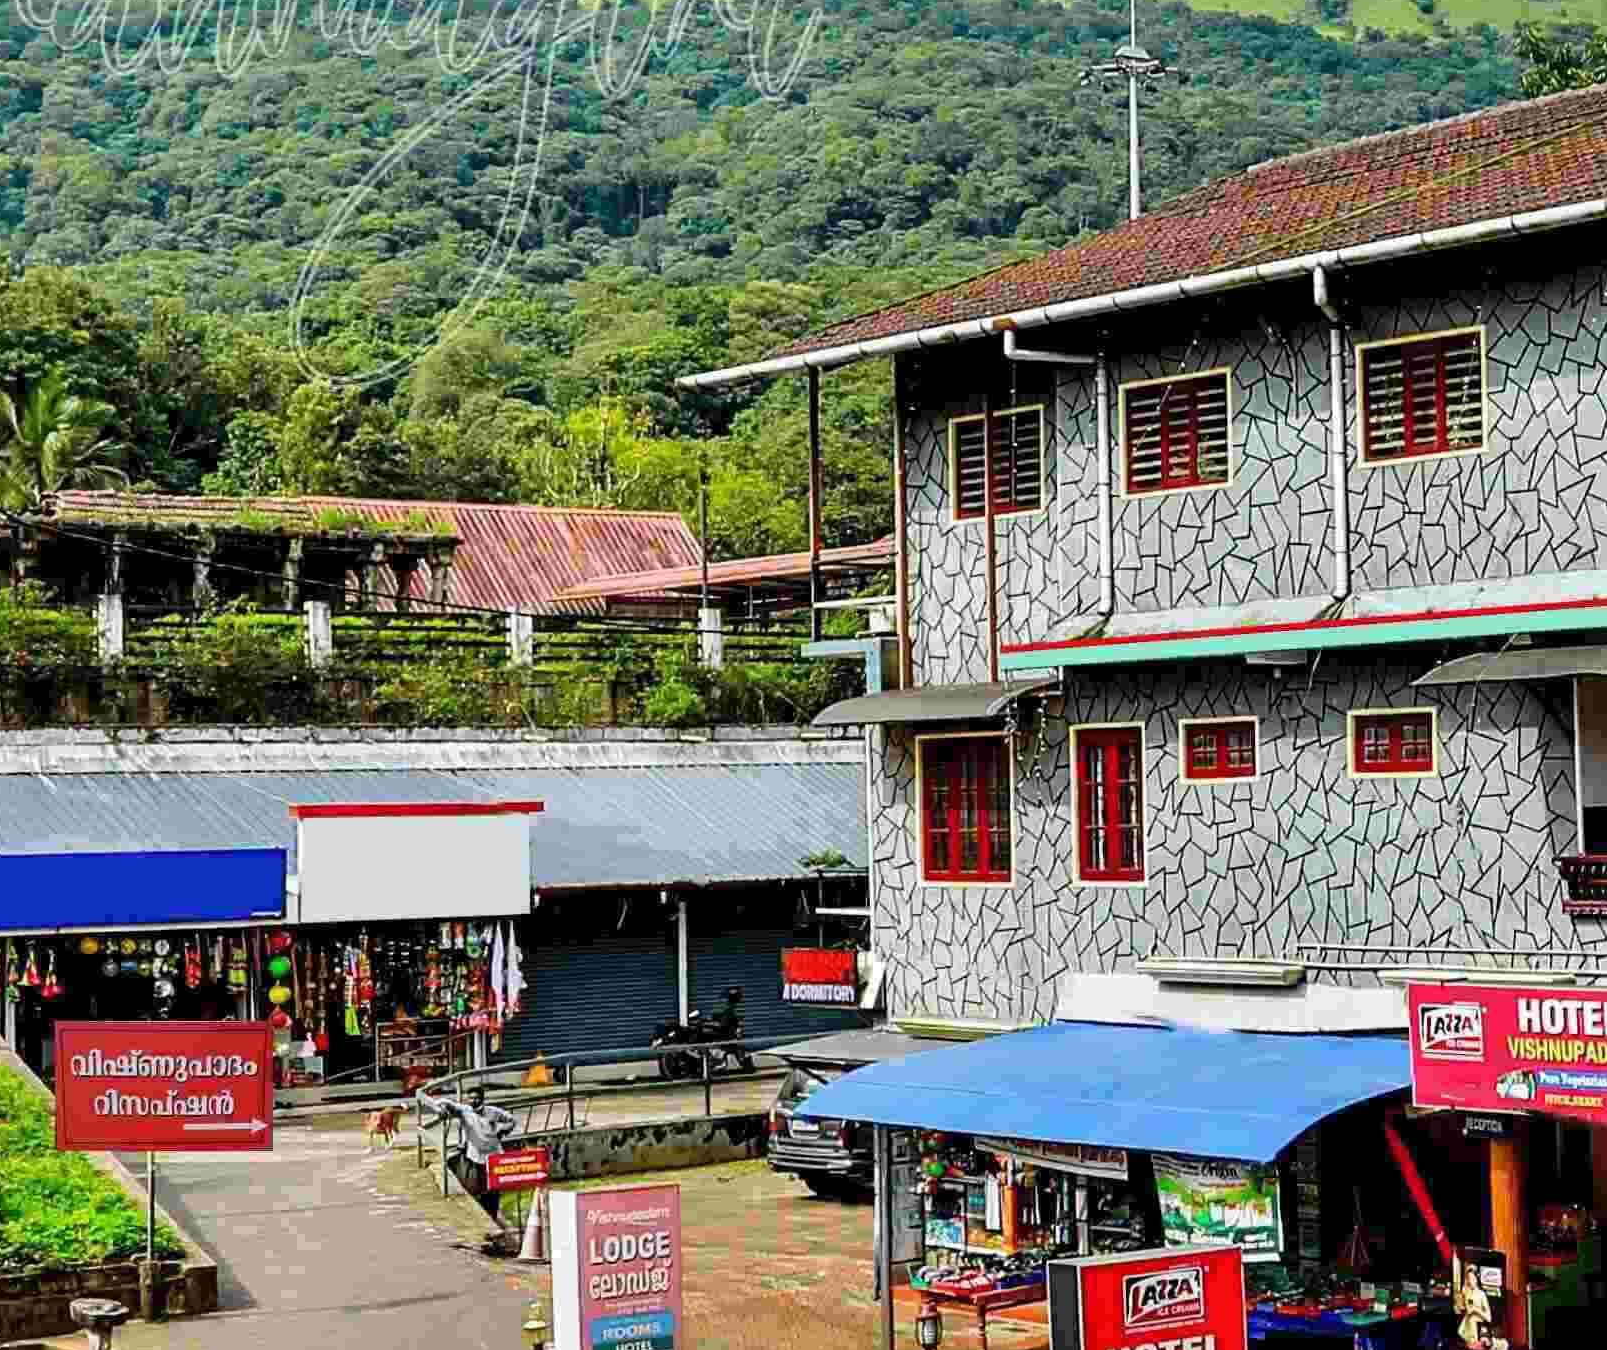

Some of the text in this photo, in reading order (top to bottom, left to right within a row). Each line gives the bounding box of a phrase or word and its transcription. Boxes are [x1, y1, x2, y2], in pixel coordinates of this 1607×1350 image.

[70, 1048, 259, 1082] വിഷ്ണുപാദം
[588, 1230, 672, 1266] LODGE
[1128, 1272, 1198, 1322] LAZZA
[602, 1321, 662, 1340] ROOMS
